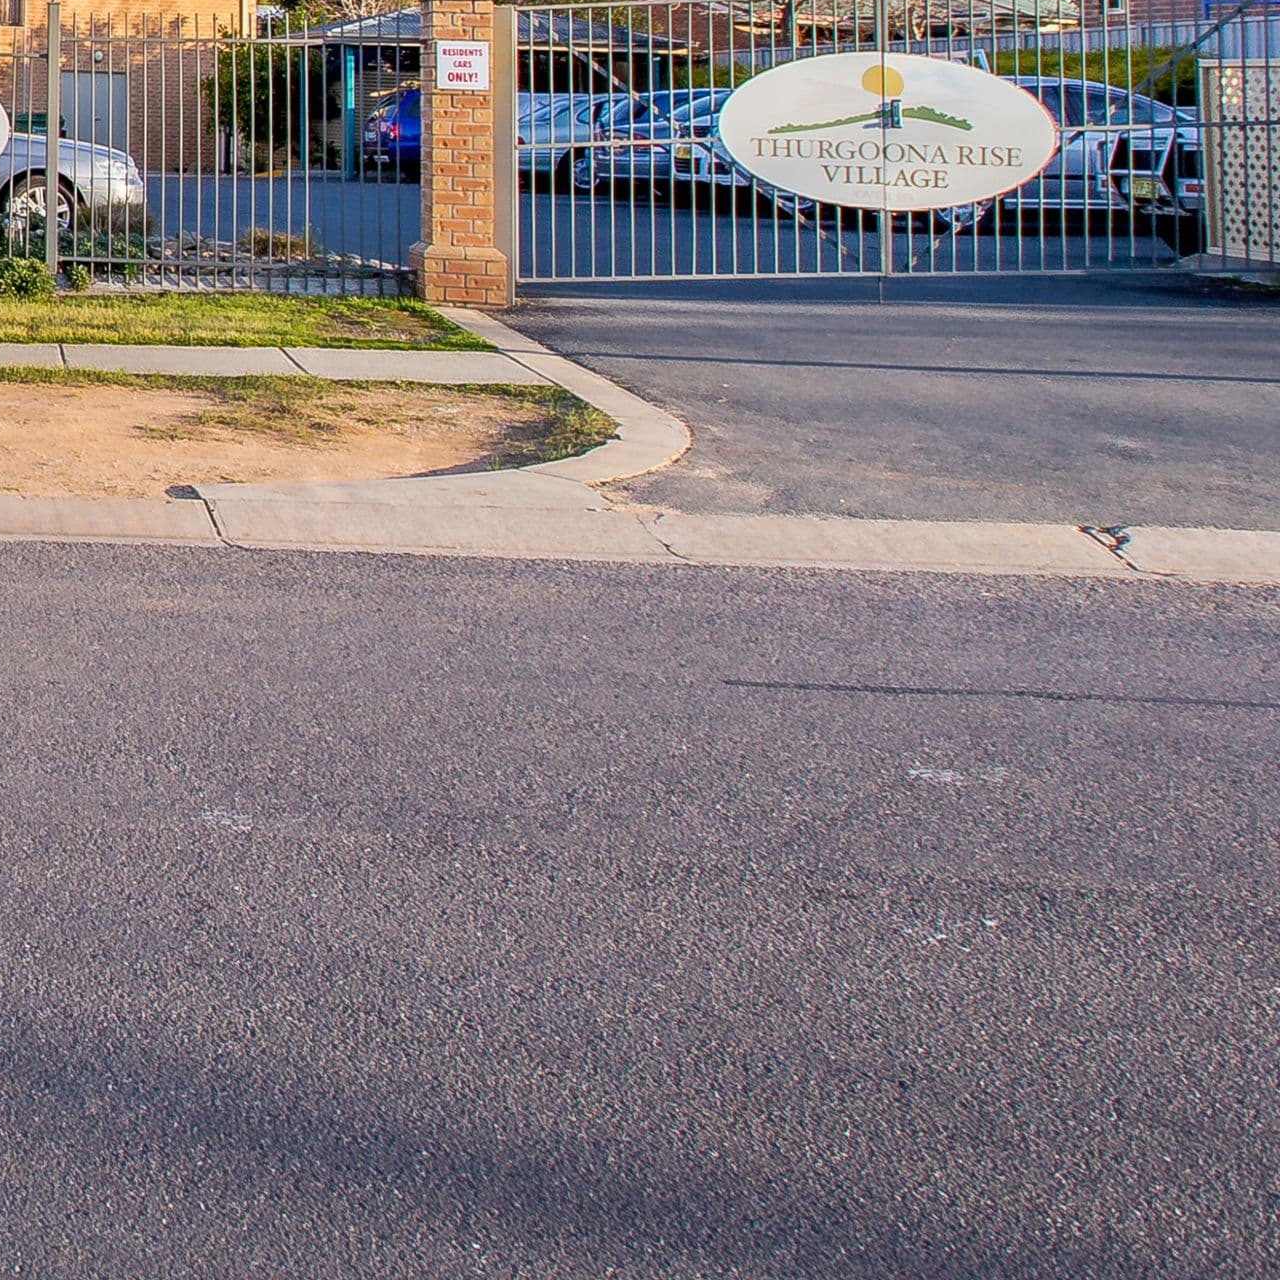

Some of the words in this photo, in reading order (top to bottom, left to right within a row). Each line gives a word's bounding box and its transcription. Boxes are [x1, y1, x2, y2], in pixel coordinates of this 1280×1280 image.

[442, 48, 483, 57] RESIDENTS
[453, 60, 472, 68] CARS
[447, 72, 479, 83] ONLY!
[750, 137, 949, 165] THURGOONA
[955, 145, 1024, 168] RISE
[821, 164, 949, 189] VILLAGE
